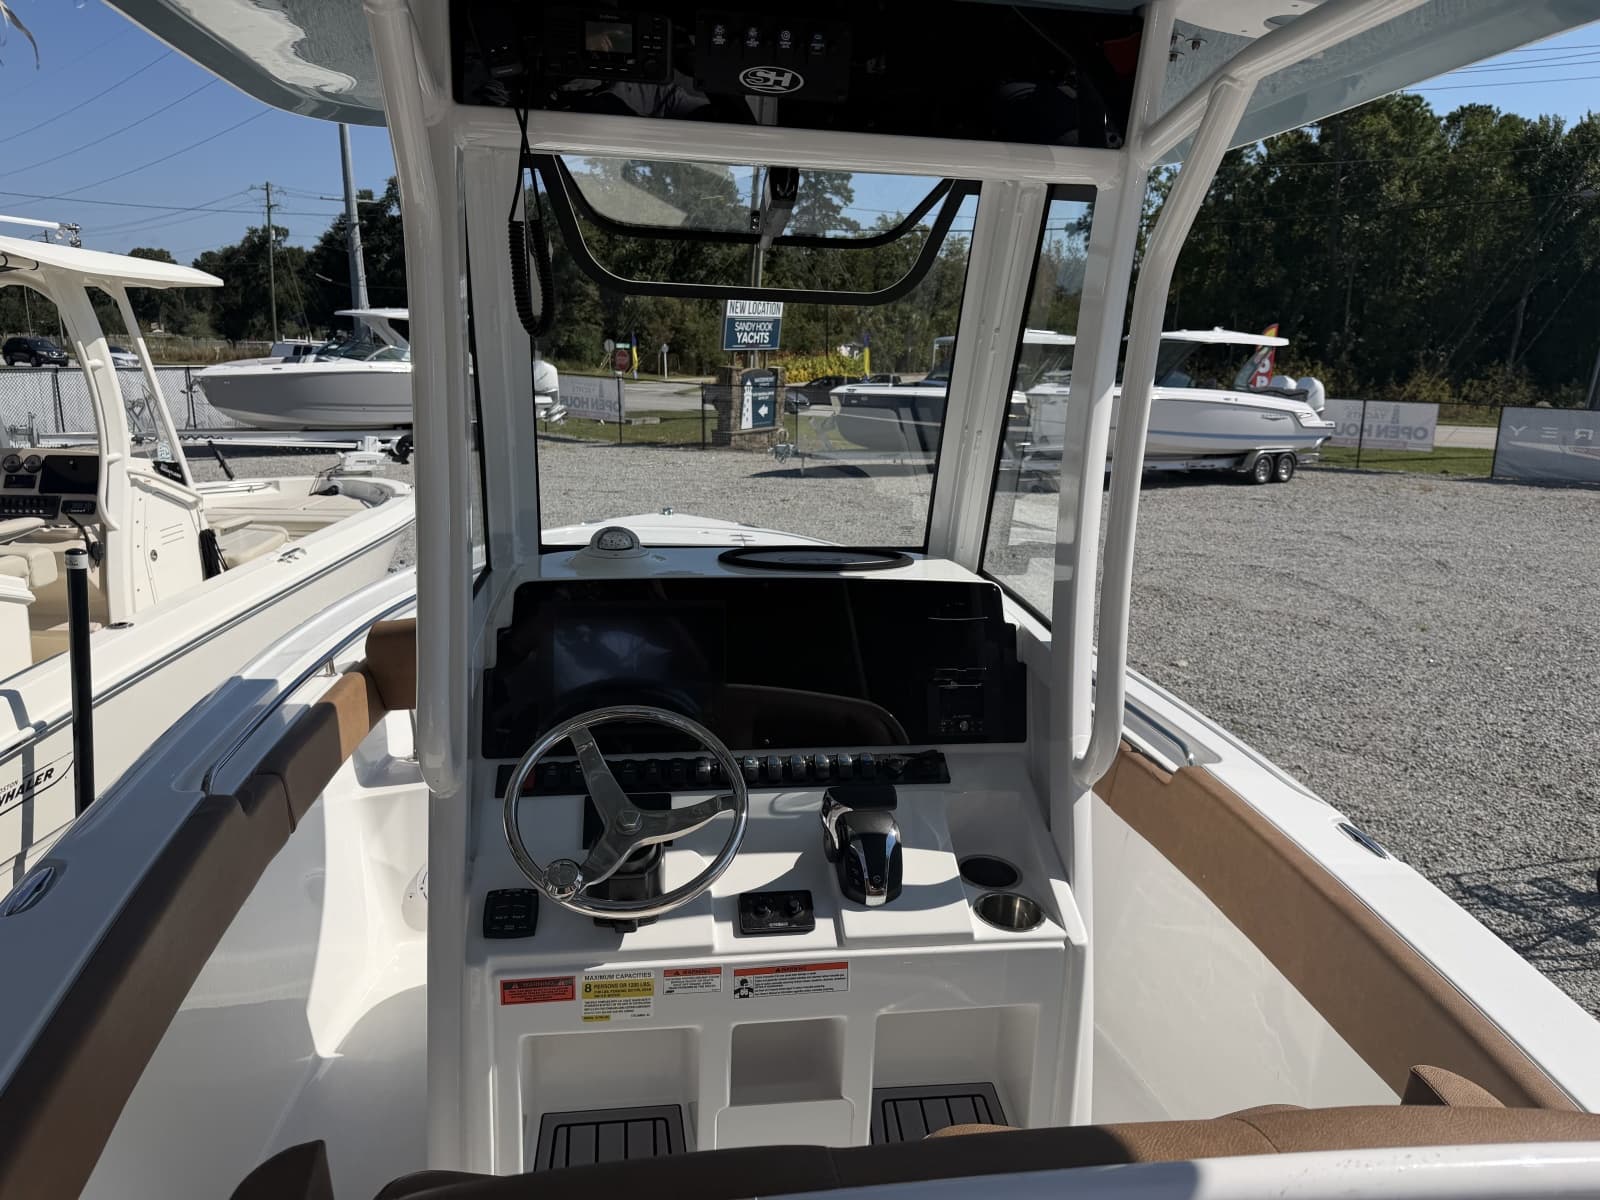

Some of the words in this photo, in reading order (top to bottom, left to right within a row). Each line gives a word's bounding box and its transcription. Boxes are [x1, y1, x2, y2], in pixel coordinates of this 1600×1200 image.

[729, 301, 746, 315] NEW
[748, 302, 781, 315] LOCATION
[735, 322, 755, 331] SANDY
[756, 322, 773, 331] HOOK
[737, 332, 770, 343] YACHTS
[584, 983, 592, 993] 8
